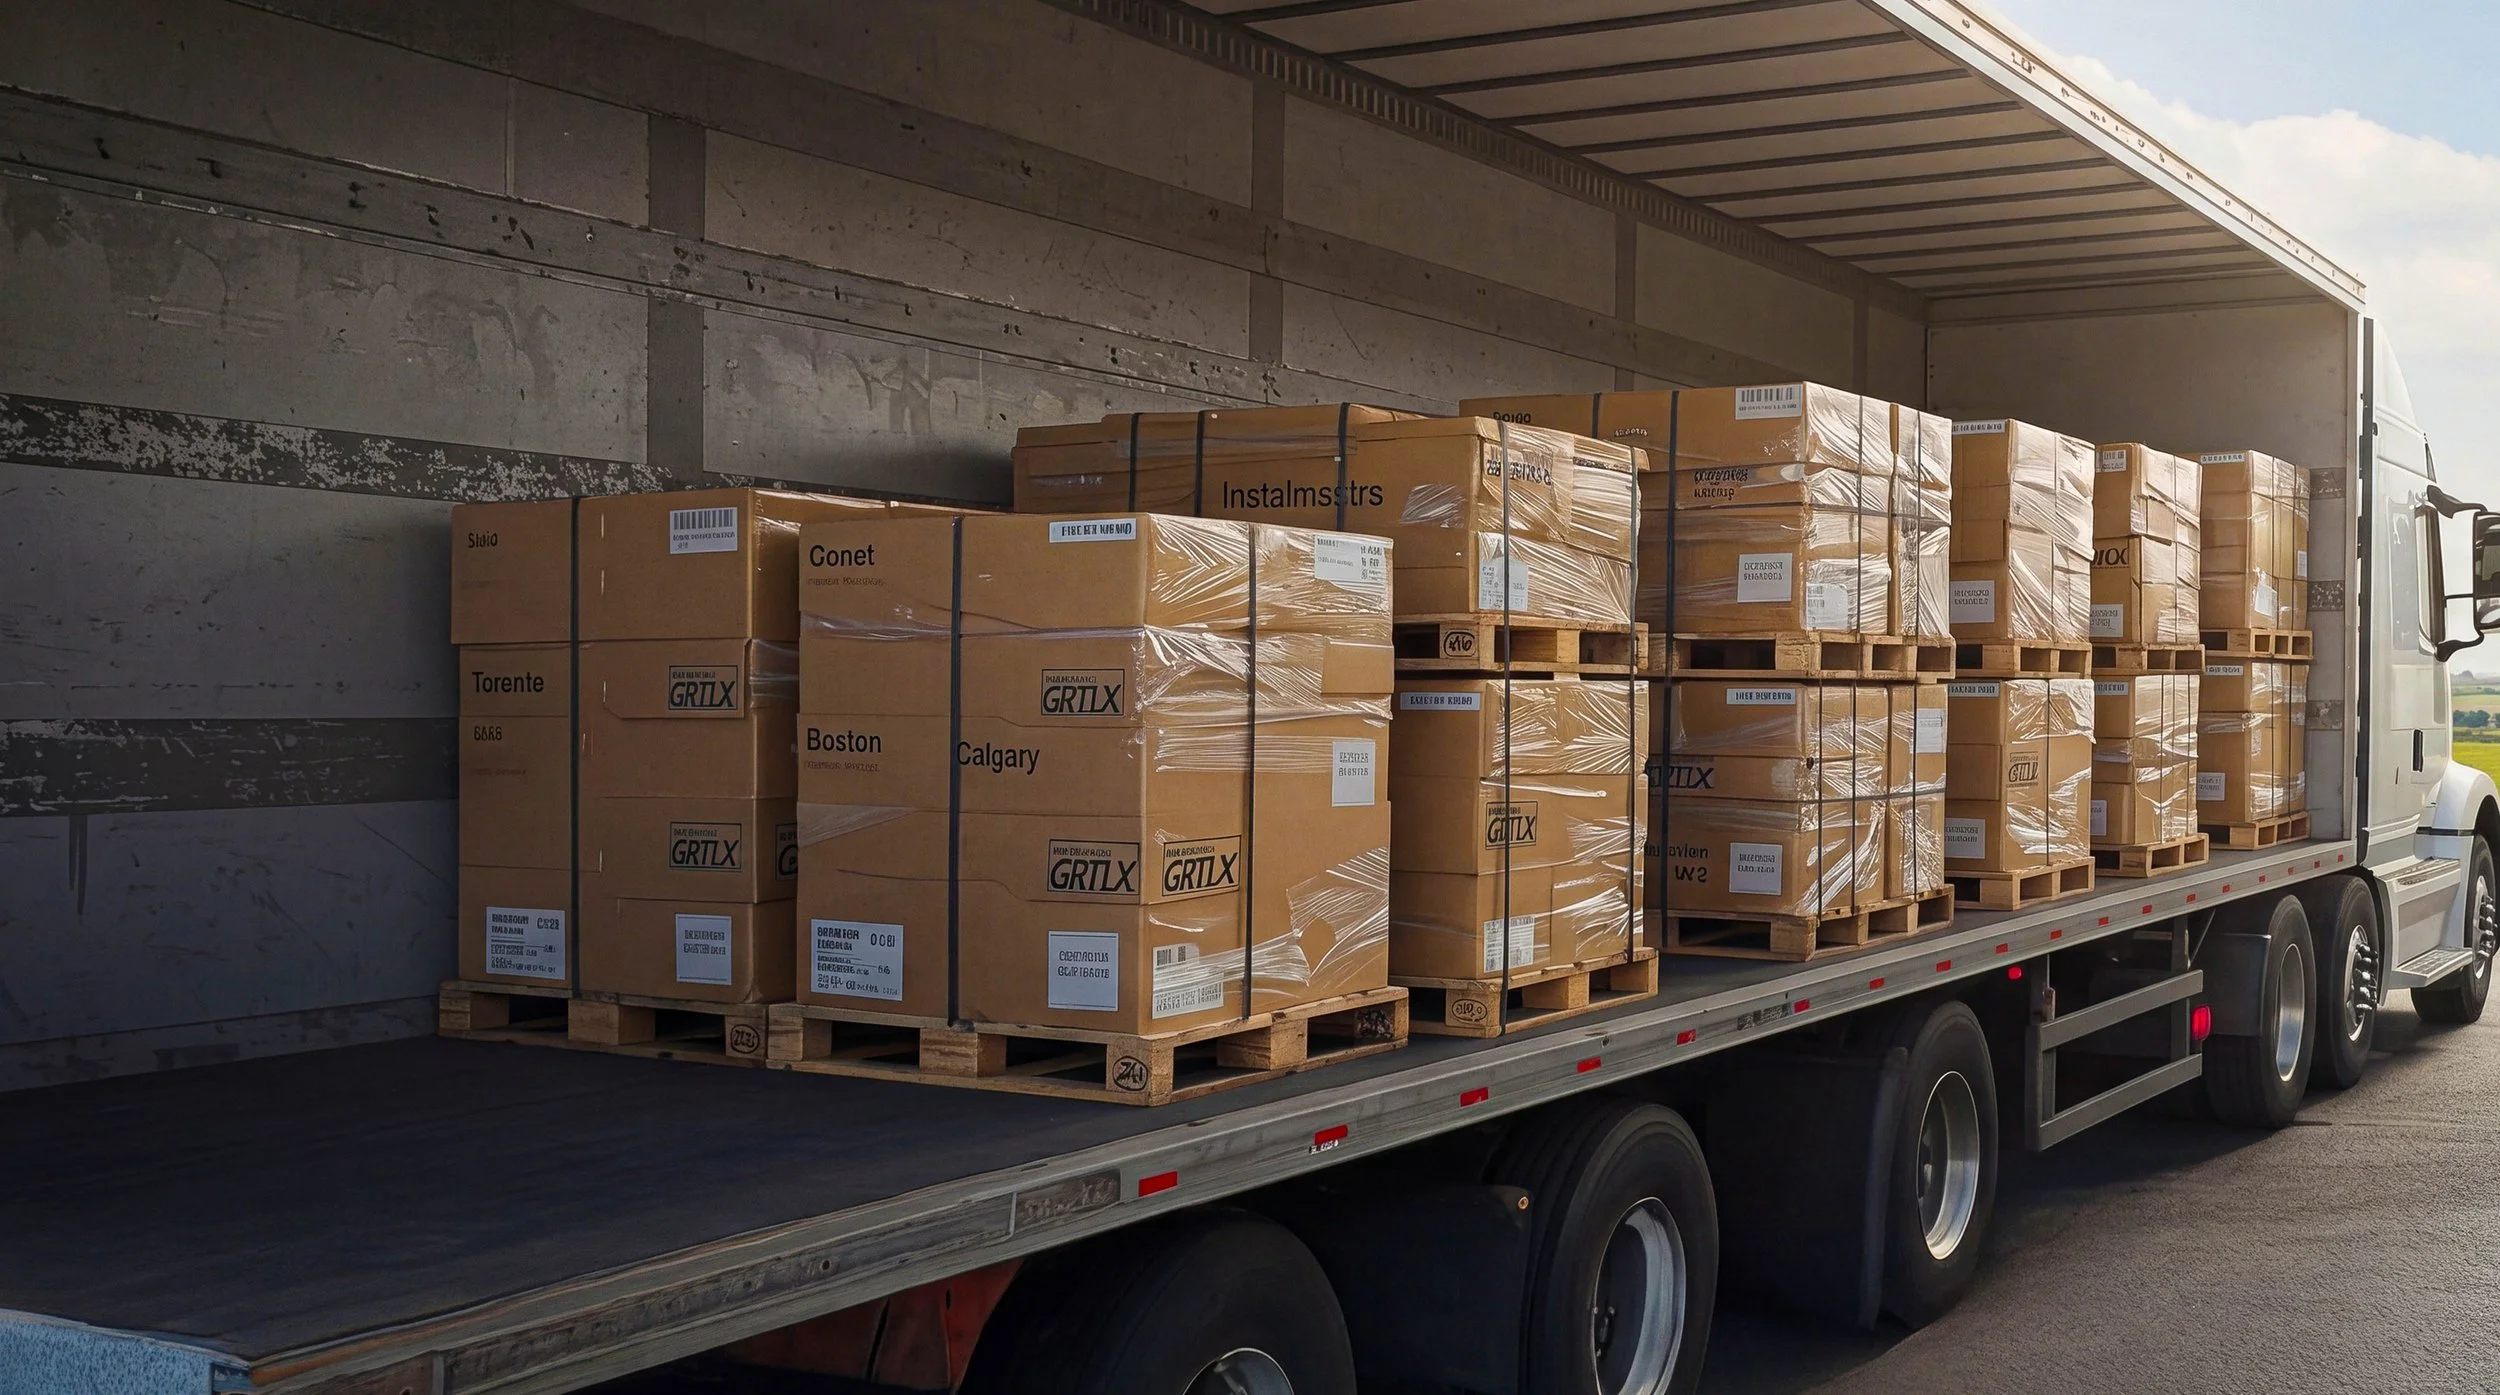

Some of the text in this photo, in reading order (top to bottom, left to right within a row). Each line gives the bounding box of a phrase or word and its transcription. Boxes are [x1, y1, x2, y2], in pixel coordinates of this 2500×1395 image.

[472, 672, 544, 692] Torente
[807, 728, 881, 752] Boston
[957, 742, 1040, 775] Calgary
[672, 839, 740, 866] GRTLX
[1051, 858, 1137, 892] GRTLX
[1164, 853, 1239, 892] GRTLX
